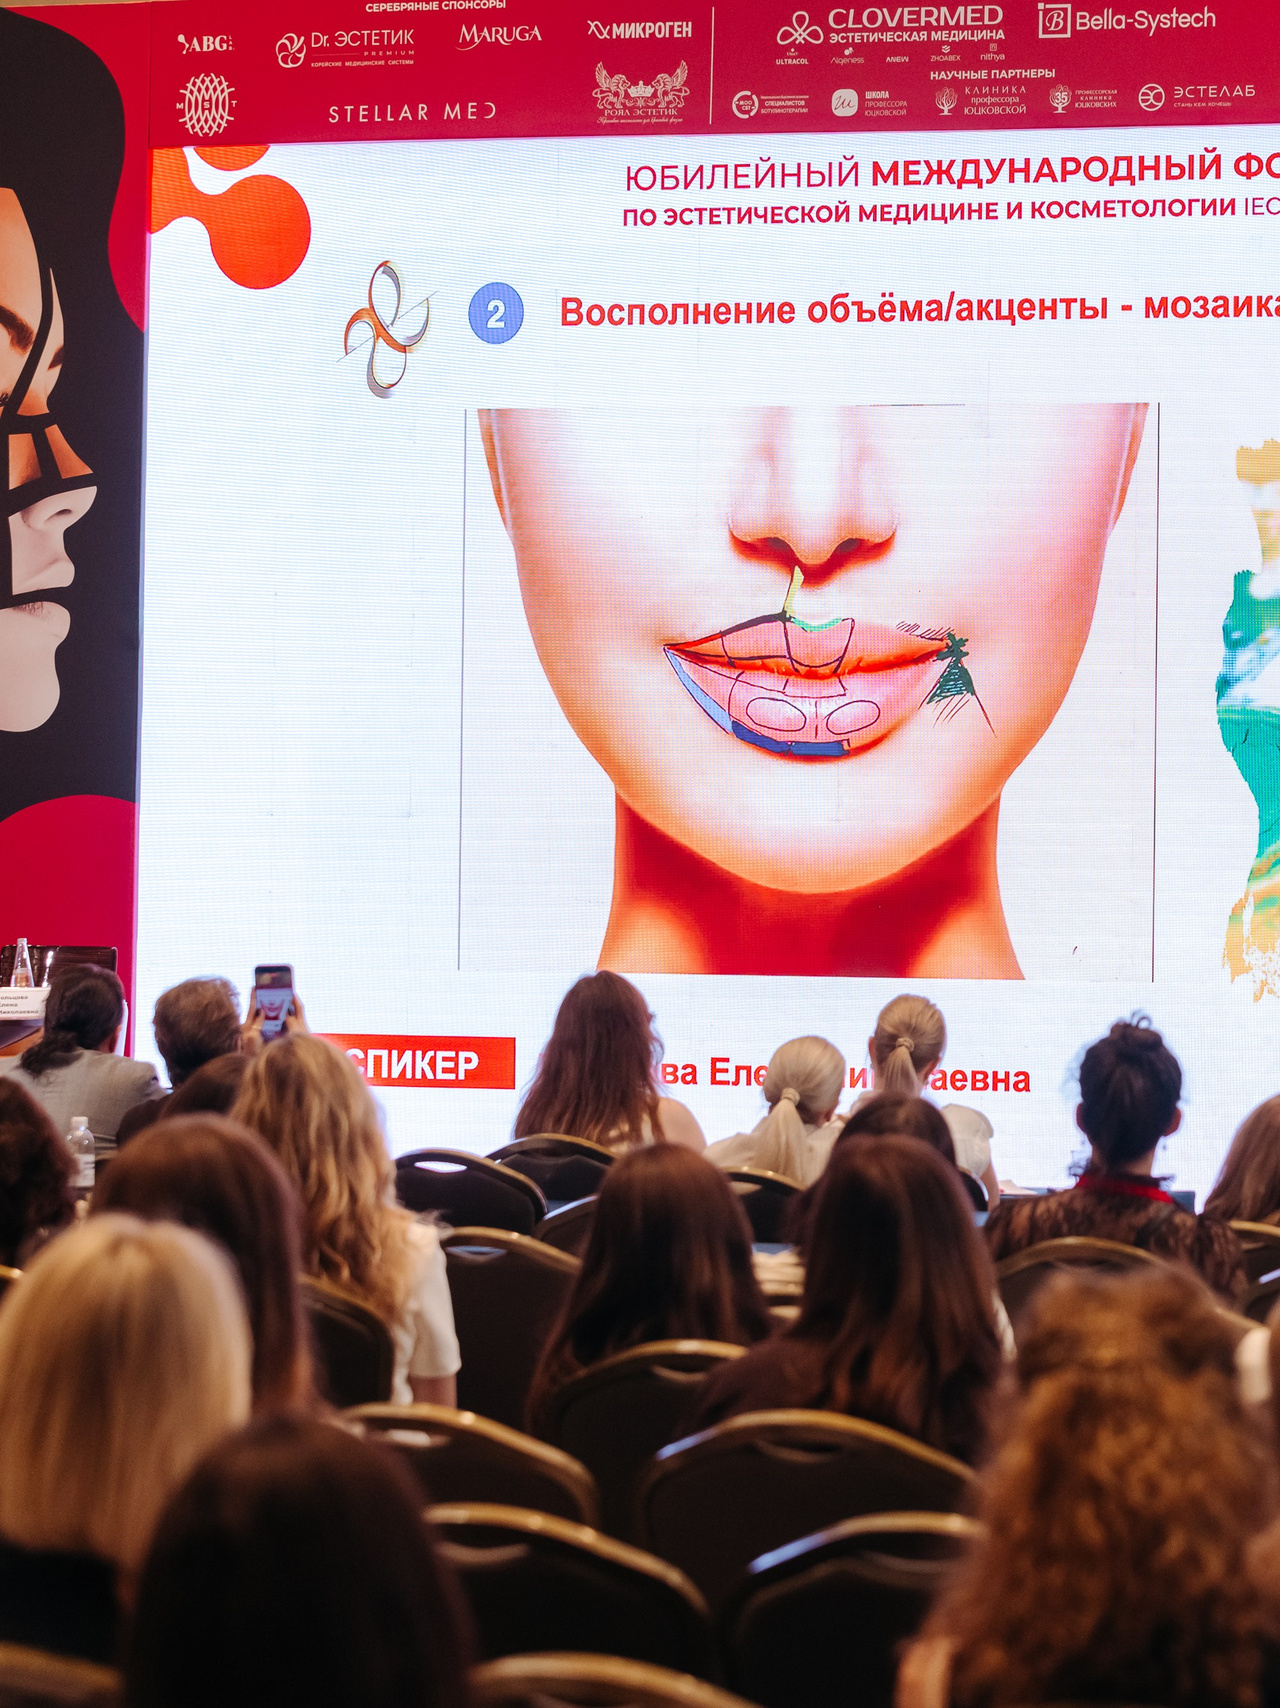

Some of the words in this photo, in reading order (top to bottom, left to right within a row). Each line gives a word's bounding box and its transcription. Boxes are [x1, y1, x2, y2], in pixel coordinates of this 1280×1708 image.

[365, 1, 439, 12] СЕРЕБРЯНЫЕ
[441, 0, 506, 10] СПОНСОРЫ
[828, 5, 1004, 28] CLOVERMED
[1076, 6, 1216, 36] Bella-Systech
[612, 21, 692, 39] МИКРОГЕН
[829, 31, 928, 44] ЭСТЕТИЧЕСКАЯ
[931, 29, 1005, 42] МЕДИЦИНА
[189, 35, 228, 52] ABG
[311, 32, 330, 48] Dr.
[334, 29, 415, 47] ЭСТЕТИК
[980, 53, 1006, 62] nithya
[930, 70, 988, 80] НАУЧНЫЕ
[991, 68, 1056, 79] ПАРТНЕРЫ
[865, 91, 890, 99] ШКОЛА
[965, 85, 1026, 95] КЛИНИКА
[1173, 84, 1256, 98] ЭСТЕЛАБ
[865, 100, 907, 108] ПРОФЕССОРА
[971, 95, 1020, 105] профессора
[328, 103, 428, 123] STELLAR
[604, 109, 631, 117] РОЯЛ
[633, 108, 678, 116] ЭСТЕТИК
[865, 109, 907, 117] ЮЦКОВСКОЙ
[964, 104, 1027, 115] ЮЦКОВСКОЙ
[625, 156, 860, 192] ЮБИЛЕЙНЫЙ
[870, 149, 1223, 190] МЕЖДУНАРОДНЫЙ
[622, 207, 657, 227] ПО
[663, 199, 851, 226] ЭСТЕТИЧЕСКОЙ
[858, 200, 1000, 226] МЕДИЦИНЕ
[1006, 200, 1023, 220] И
[1030, 198, 1237, 220] КОСМЕТОЛОГИИ
[486, 299, 506, 329] 2
[561, 295, 796, 327] Восполнение
[807, 290, 1108, 325] объёма/акценты
[710, 1057, 769, 1086] Еле
